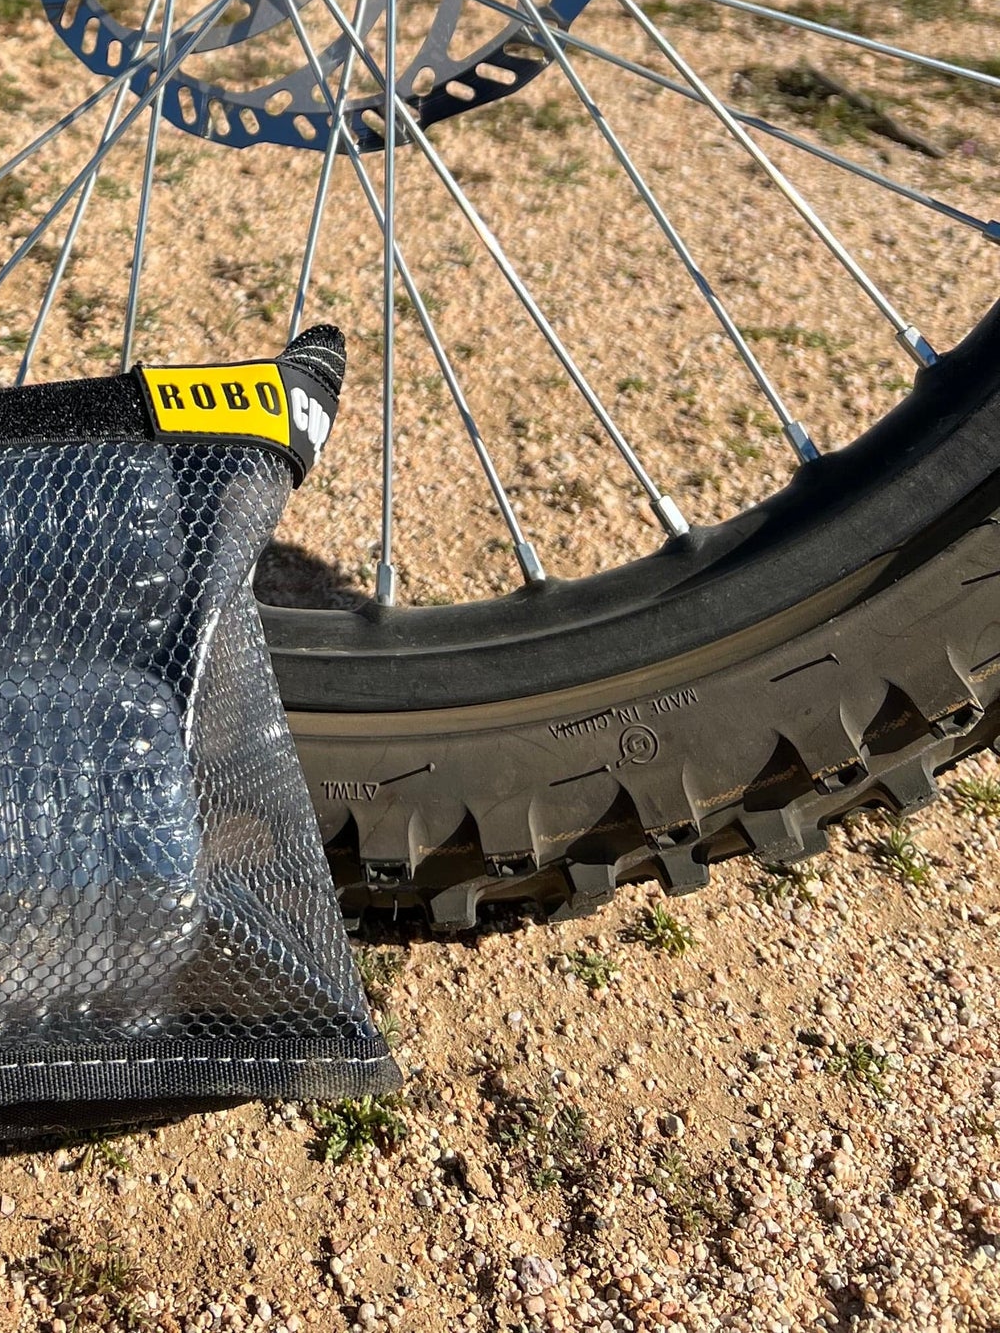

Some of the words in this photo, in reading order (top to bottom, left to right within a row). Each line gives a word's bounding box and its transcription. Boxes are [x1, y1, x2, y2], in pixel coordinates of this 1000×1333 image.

[157, 380, 282, 416] ROBO
[617, 705, 642, 725] IN
[650, 687, 699, 716] MADE
[548, 713, 611, 740] CHINA
